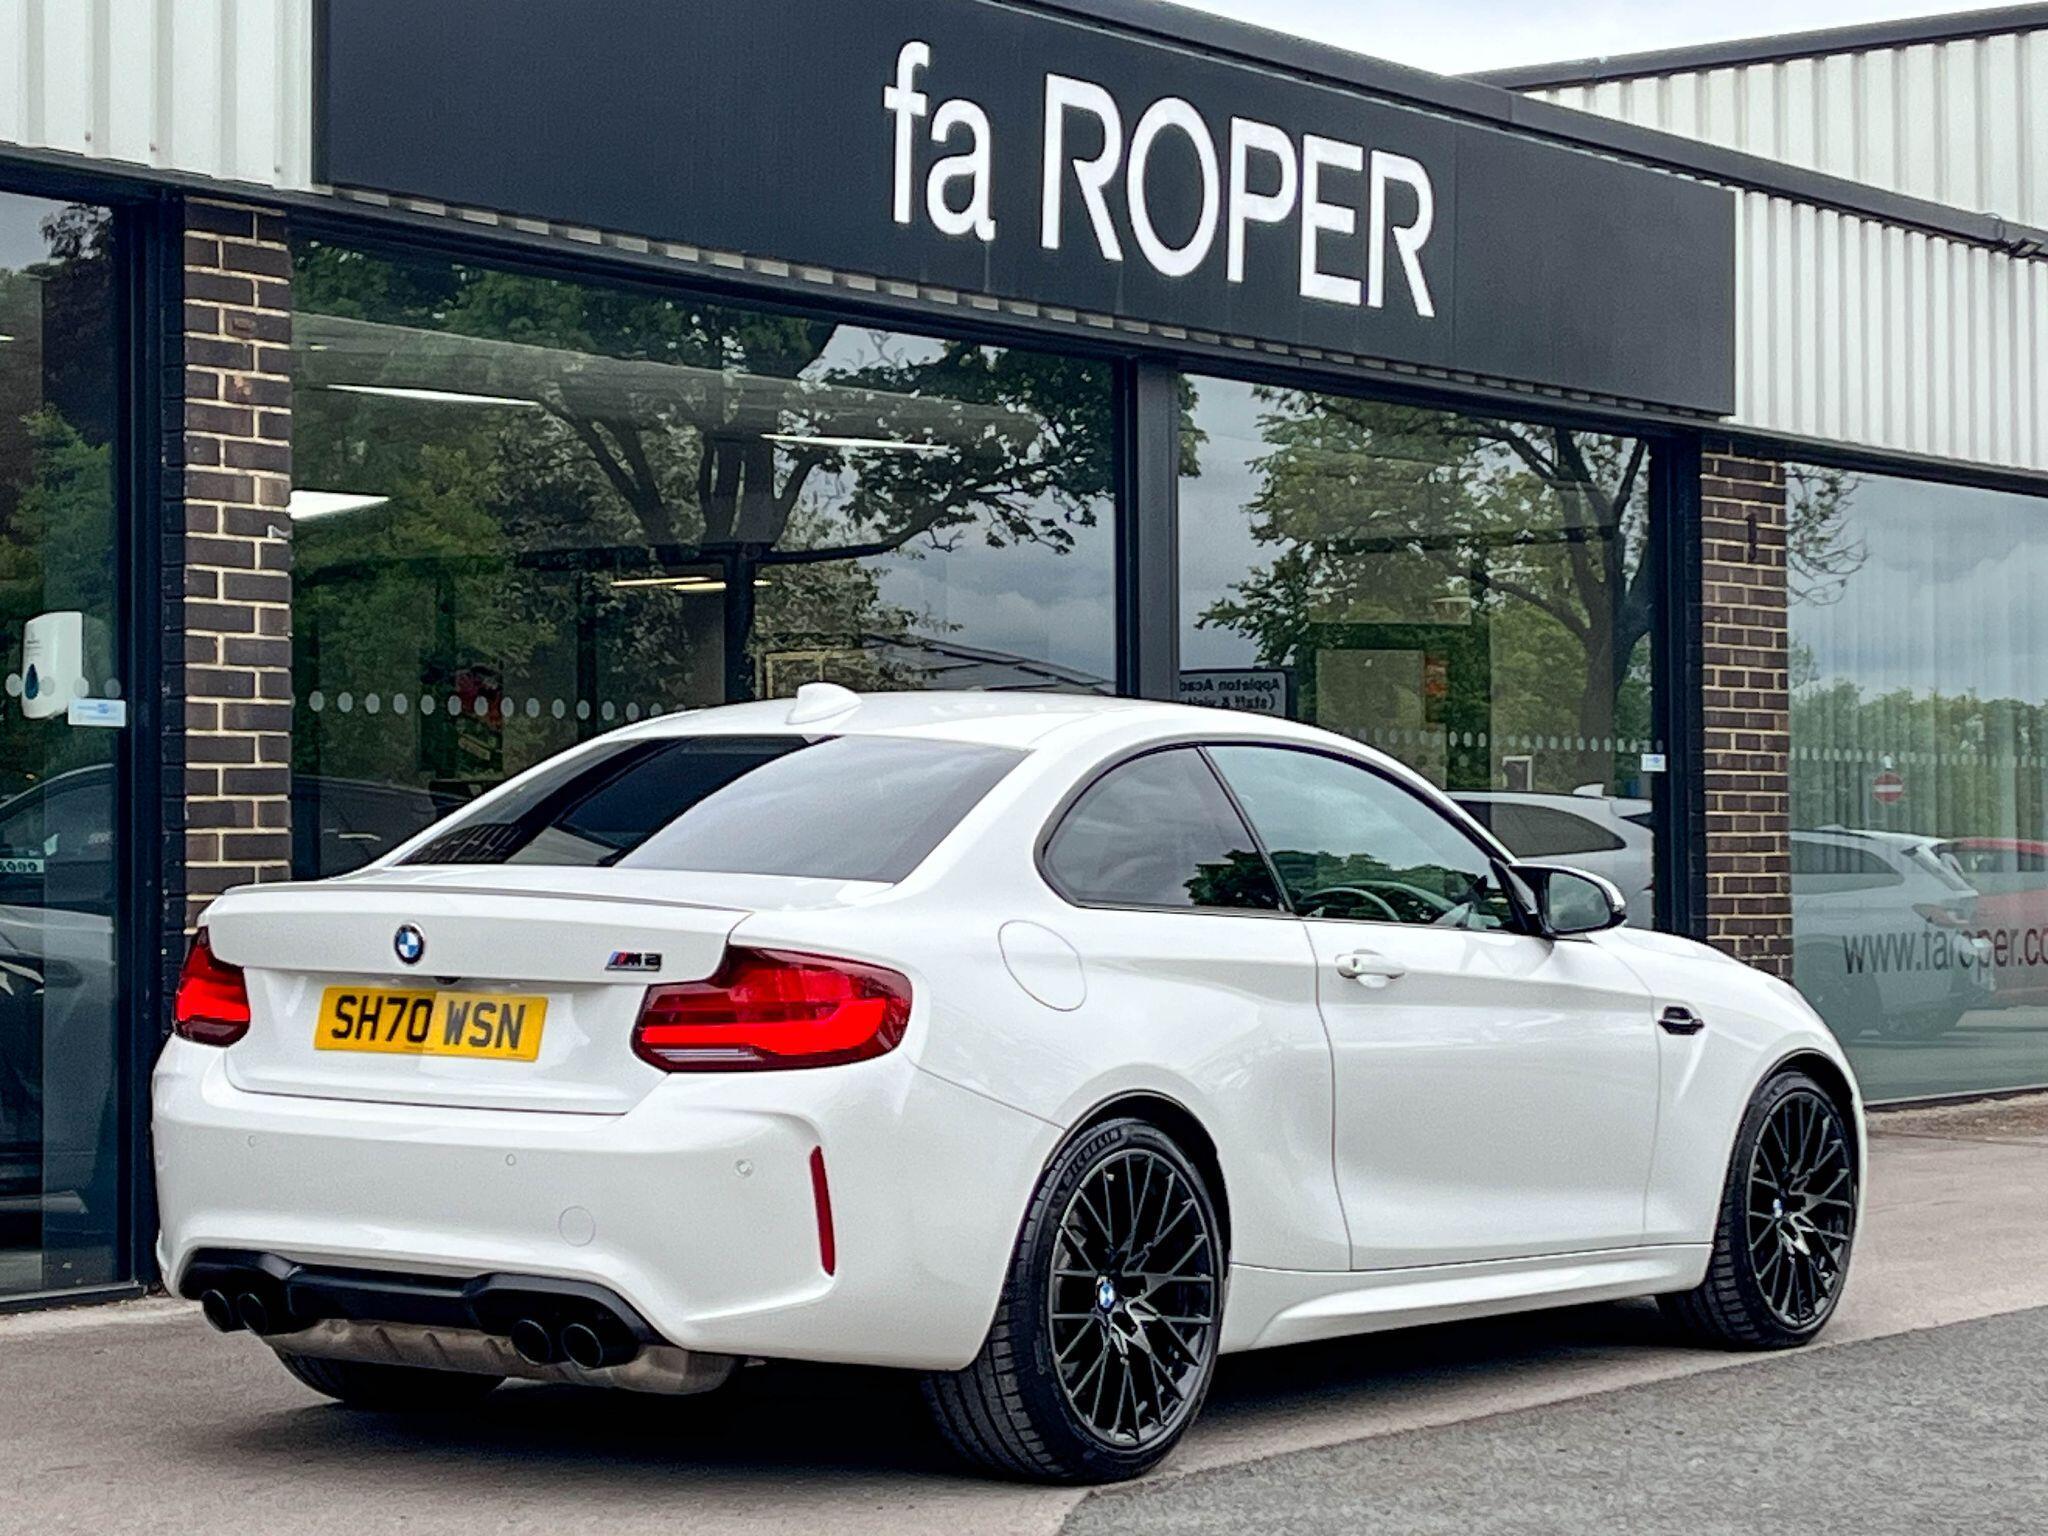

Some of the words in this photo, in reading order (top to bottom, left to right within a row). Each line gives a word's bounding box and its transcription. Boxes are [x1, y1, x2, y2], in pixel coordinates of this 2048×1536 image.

[883, 40, 996, 243] fa
[1040, 72, 1436, 319] ROPER
[331, 994, 434, 1043] SH70
[443, 1000, 526, 1050] WSN
